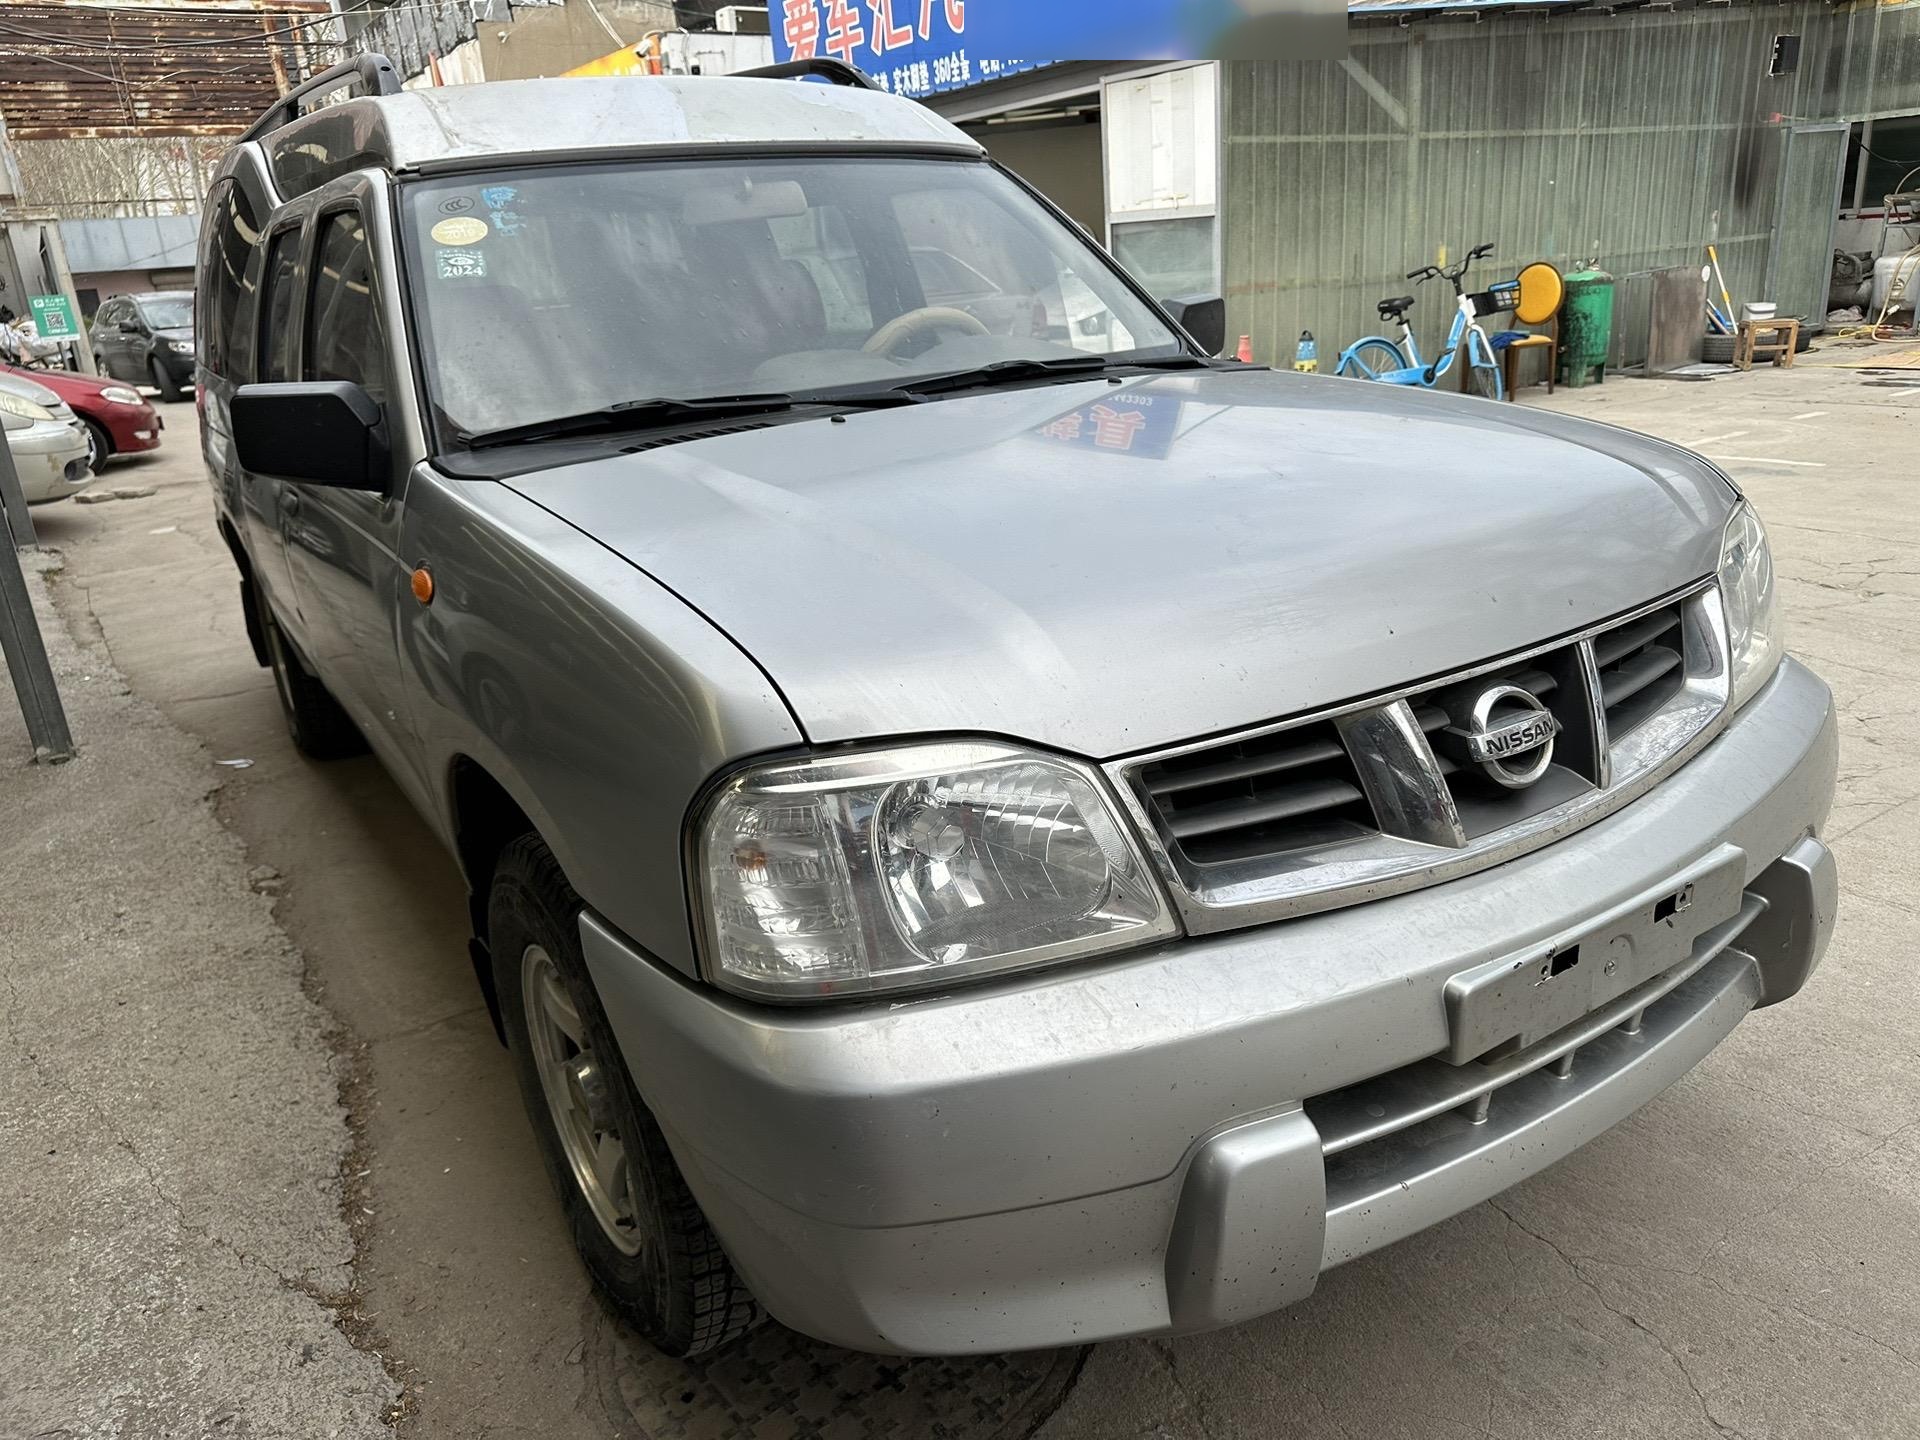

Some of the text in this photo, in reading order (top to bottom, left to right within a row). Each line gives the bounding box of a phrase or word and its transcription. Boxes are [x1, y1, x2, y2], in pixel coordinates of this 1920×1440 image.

[933, 49, 970, 85] 360全景
[443, 266, 483, 277] 2024
[1486, 721, 1554, 754] NISSAN
